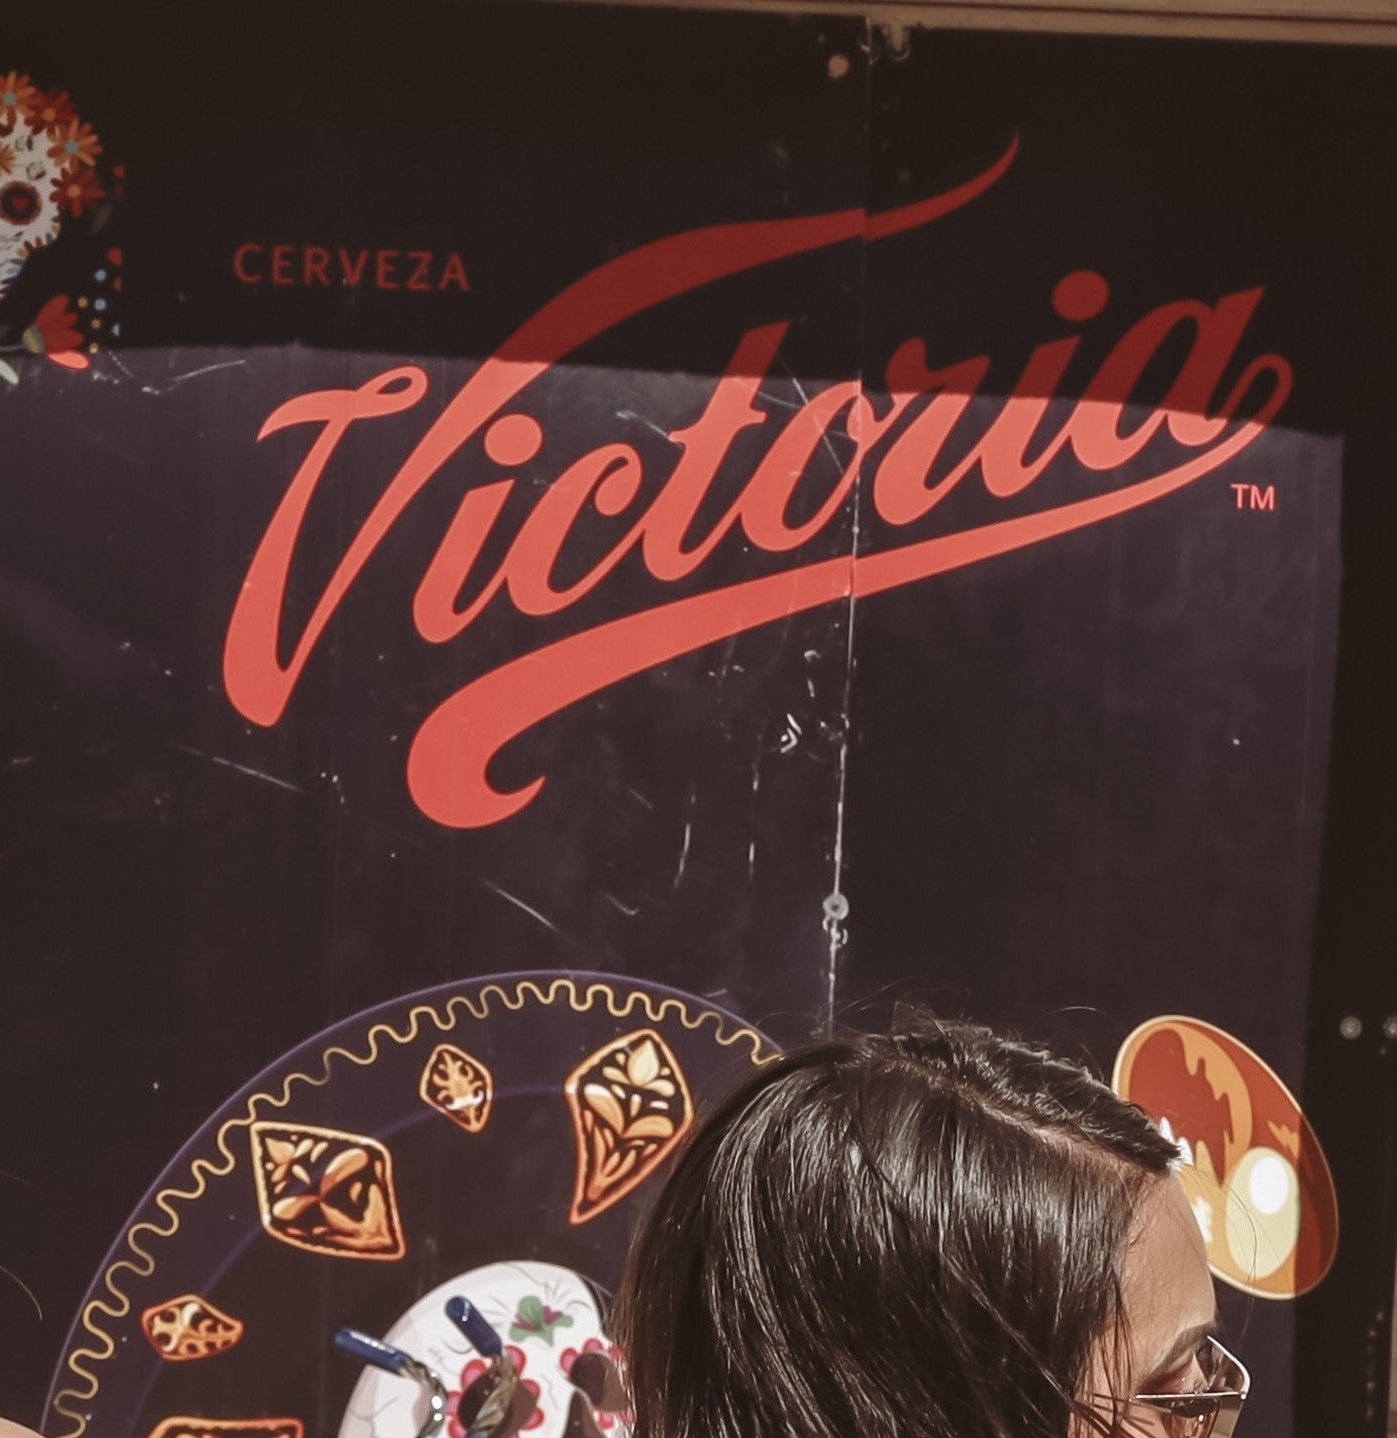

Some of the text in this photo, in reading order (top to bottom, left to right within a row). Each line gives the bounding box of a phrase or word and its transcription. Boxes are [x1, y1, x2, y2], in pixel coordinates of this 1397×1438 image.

[232, 243, 470, 292] CERVEZA
[222, 130, 1294, 830] Victoria
[1229, 482, 1276, 511] TM
